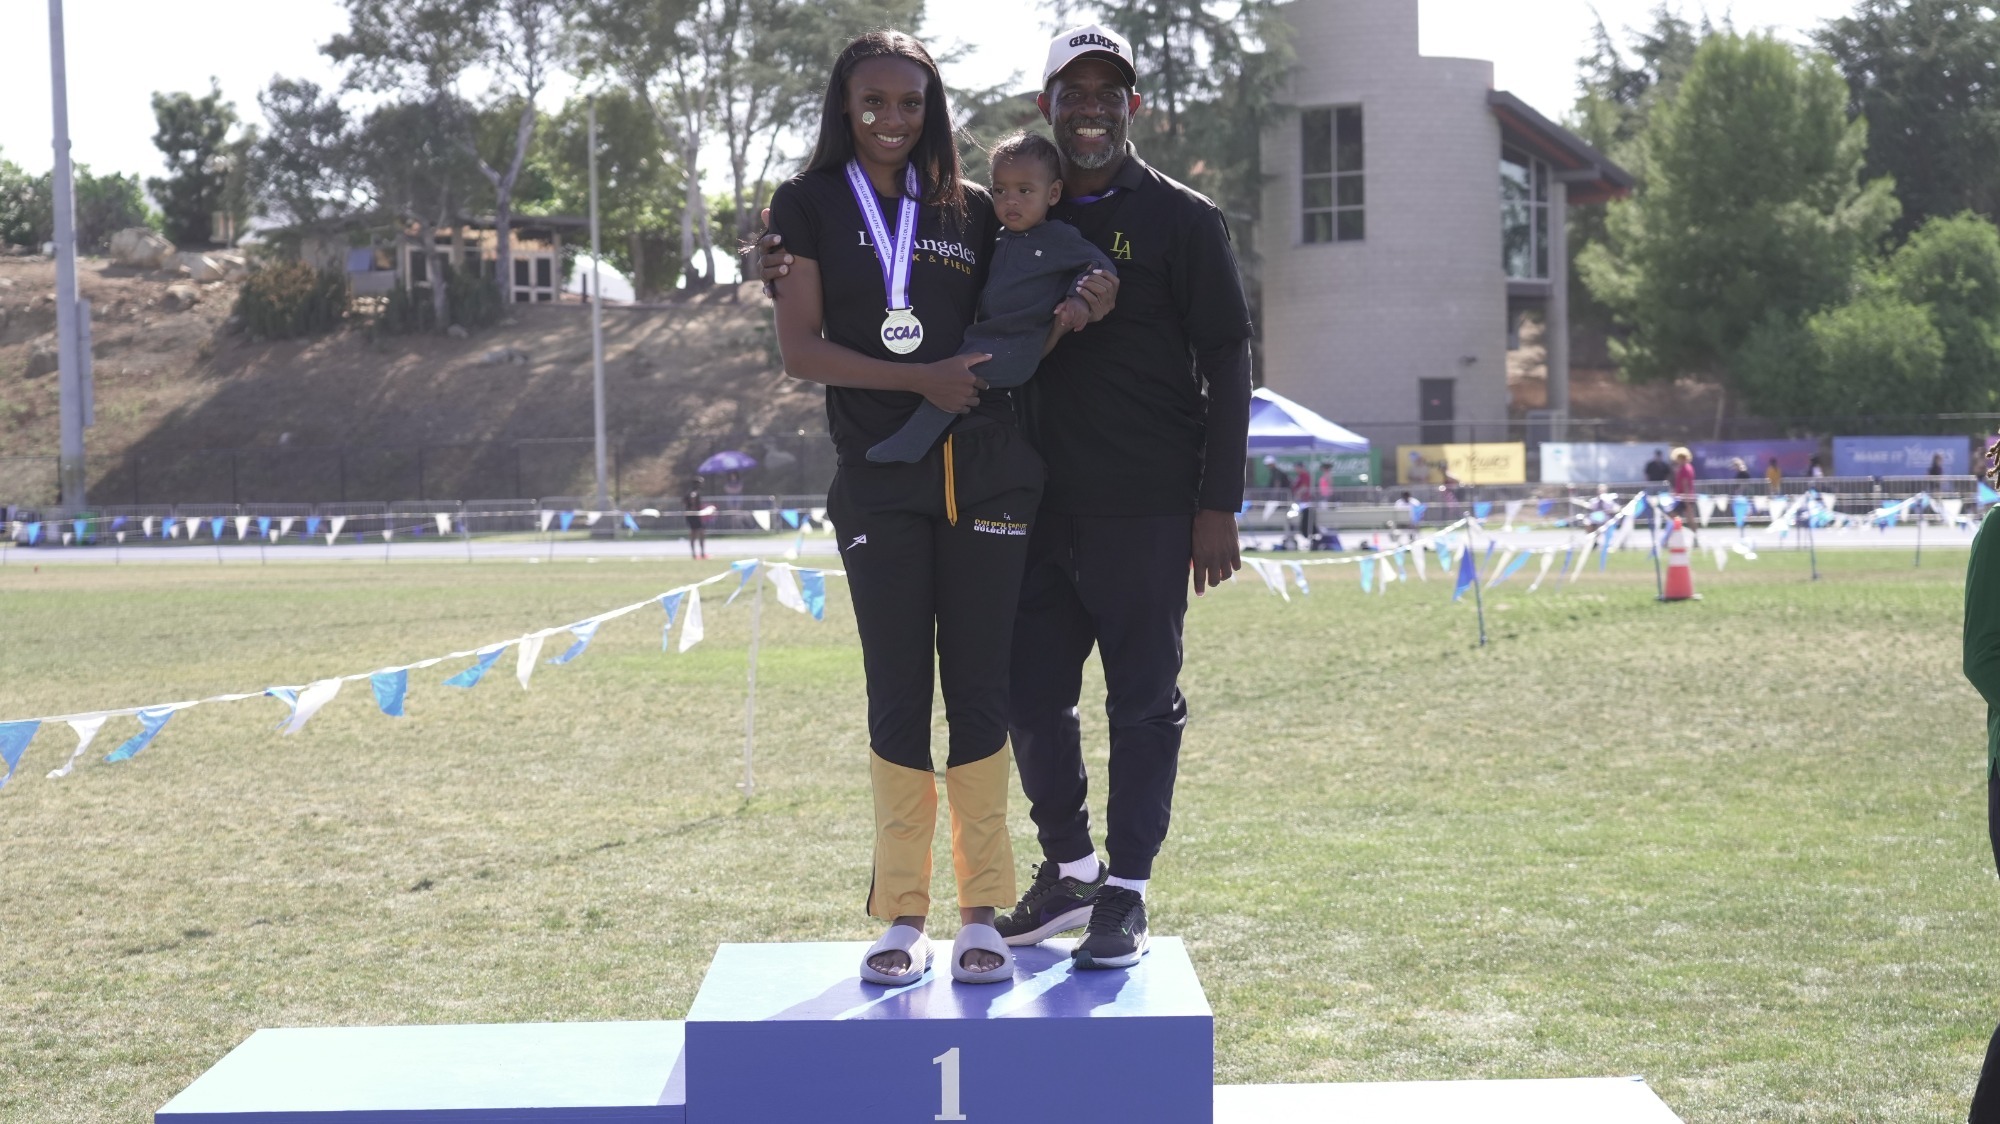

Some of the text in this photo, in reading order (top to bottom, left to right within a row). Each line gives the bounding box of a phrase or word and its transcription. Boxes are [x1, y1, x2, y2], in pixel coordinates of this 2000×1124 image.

[1069, 33, 1120, 53] GRAMPS
[869, 208, 880, 229] ATHLETIC
[877, 230, 891, 260] ASSOCIATION
[899, 236, 907, 263] CALIFORNIA
[903, 210, 911, 236] COLLEGIATE
[1110, 231, 1132, 260] LA
[928, 254, 936, 263] &
[944, 257, 971, 275] FIELD
[883, 324, 921, 342] CCAA
[932, 1047, 967, 1121] 1
